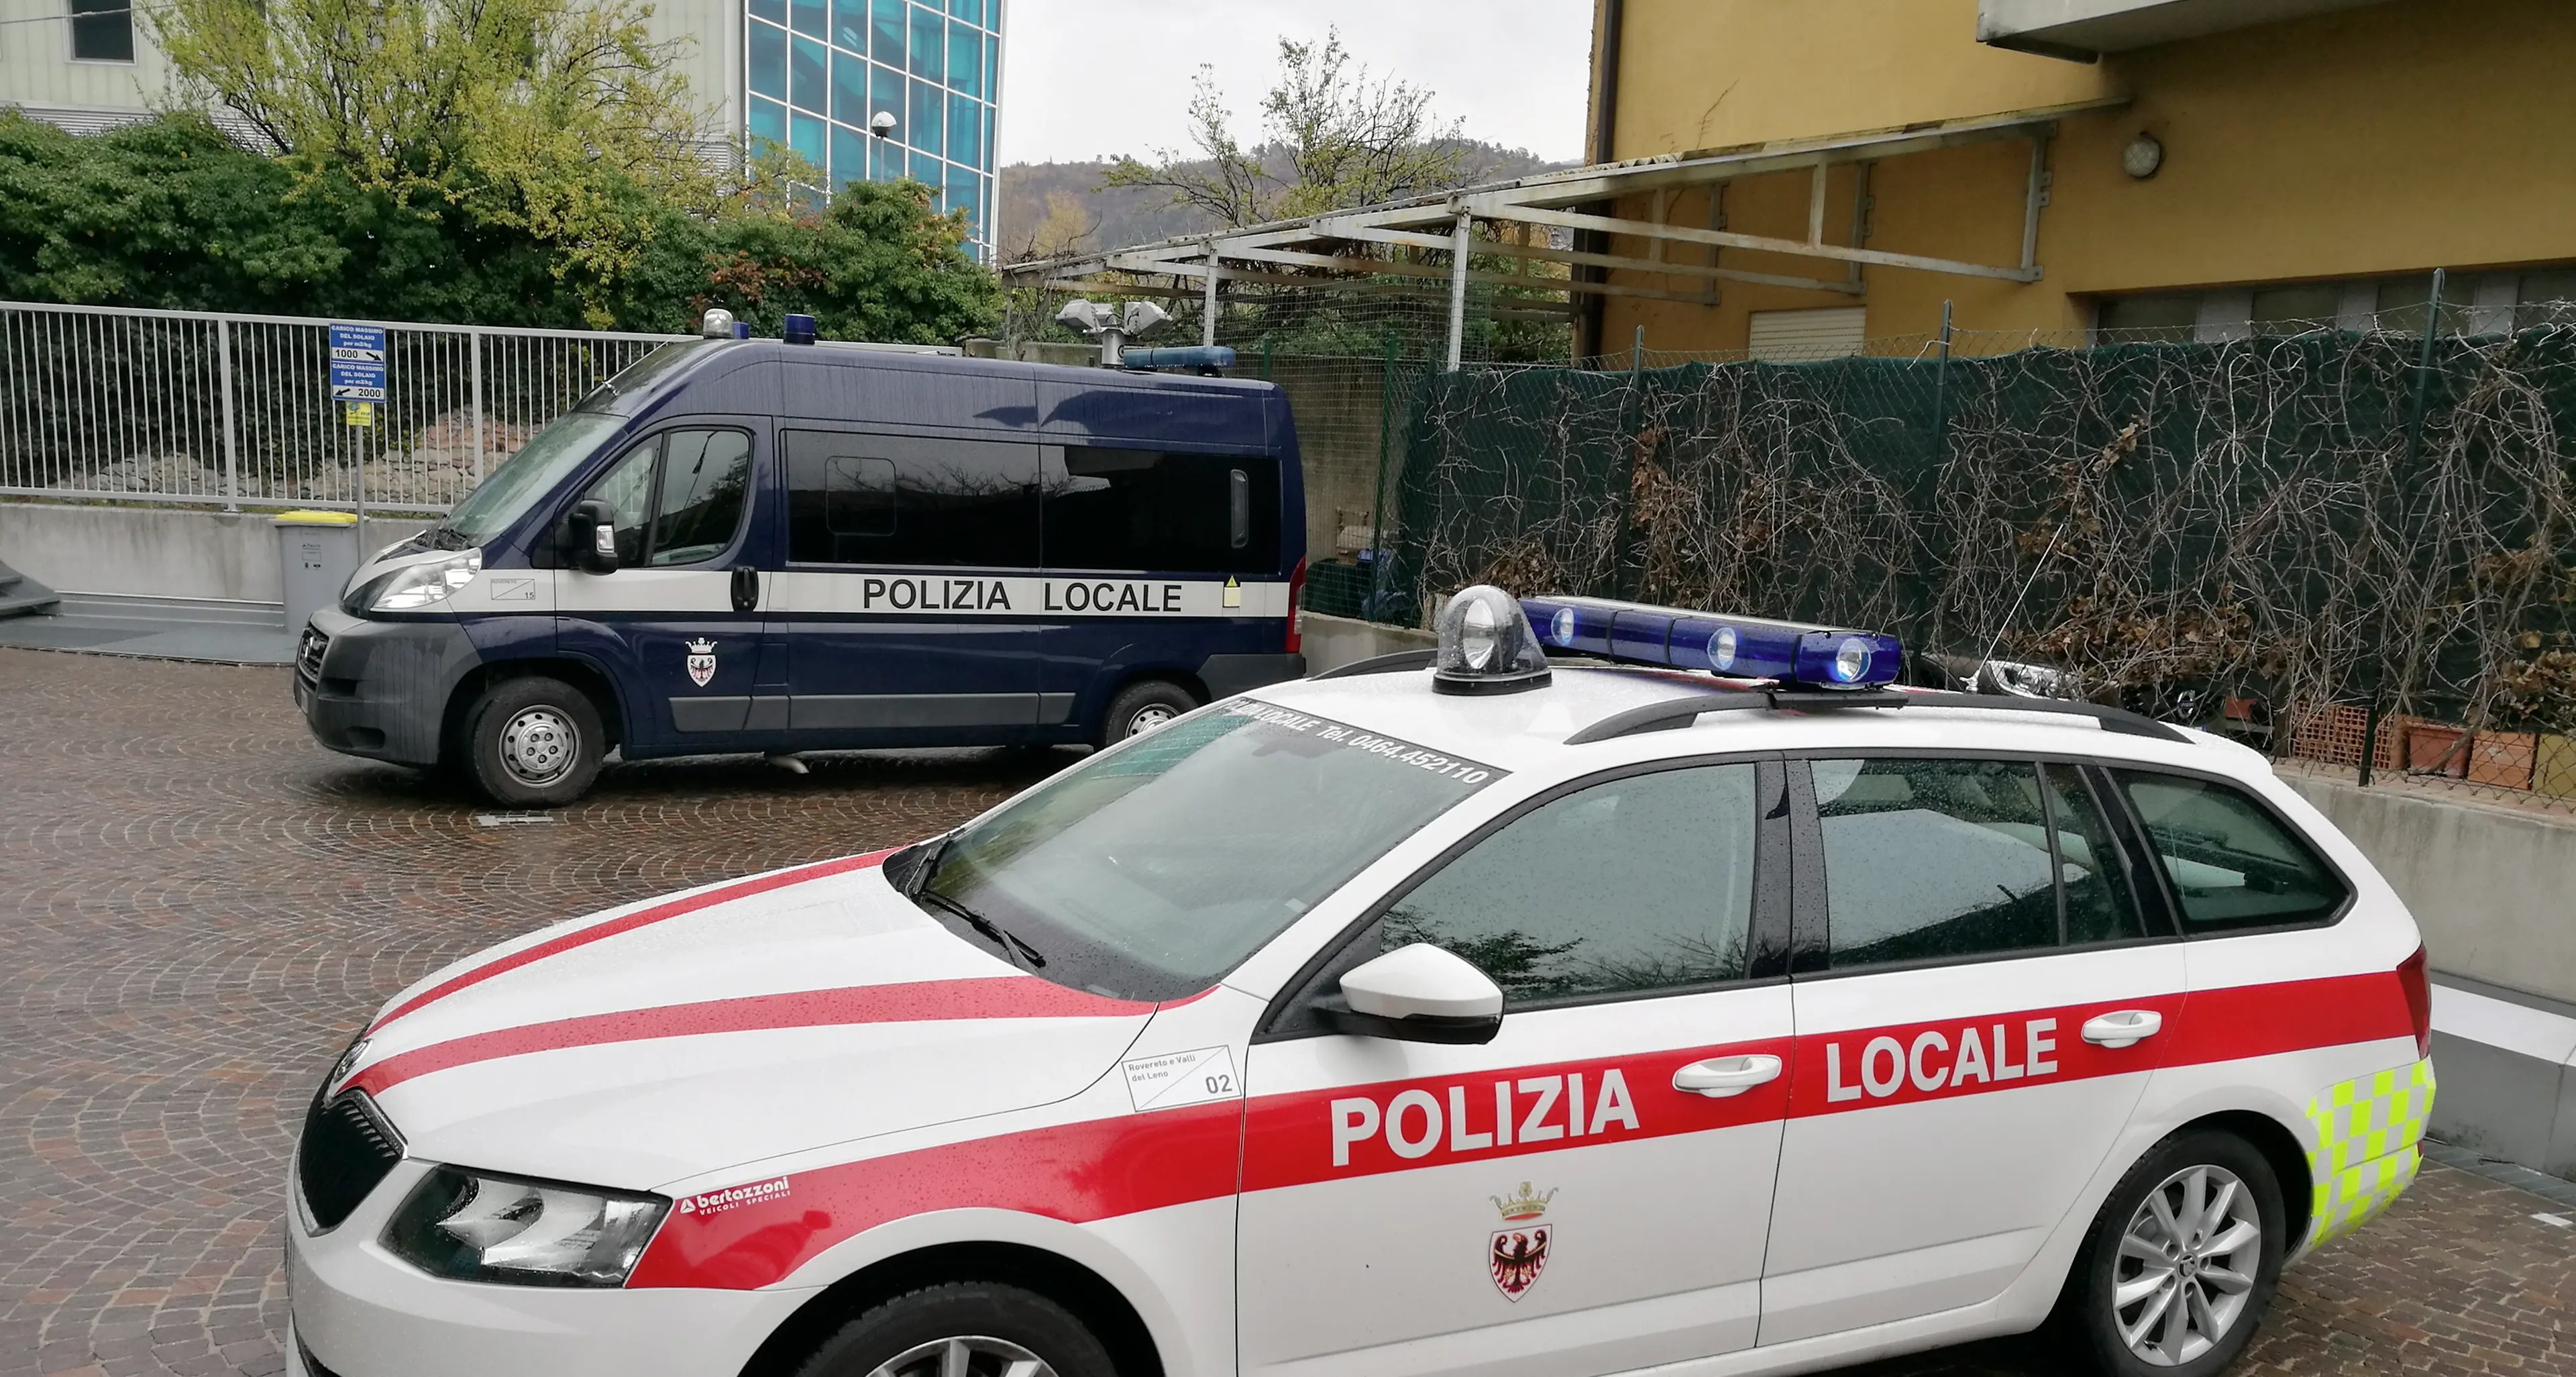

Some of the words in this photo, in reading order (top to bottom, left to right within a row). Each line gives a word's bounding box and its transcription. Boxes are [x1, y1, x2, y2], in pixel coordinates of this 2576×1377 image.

[335, 349, 358, 358] 1000
[358, 389, 380, 397] 2000
[863, 578, 1012, 610] POLIZIA
[1044, 582, 1183, 612] LOCALE
[1253, 709, 1321, 731] LOCALE
[1316, 725, 1343, 743] Tel.
[1128, 1060, 1167, 1072] Rovereto
[1175, 1054, 1195, 1064] Valli
[1132, 1074, 1146, 1082] del
[1205, 1074, 1232, 1094] 02
[1332, 1068, 1639, 1167] POLIZIA
[1825, 1018, 2058, 1103] LOCALE
[697, 1176, 789, 1208] bertazzoni
[700, 1203, 739, 1215] VEICOLI
[746, 1190, 790, 1205] SPECIALI
